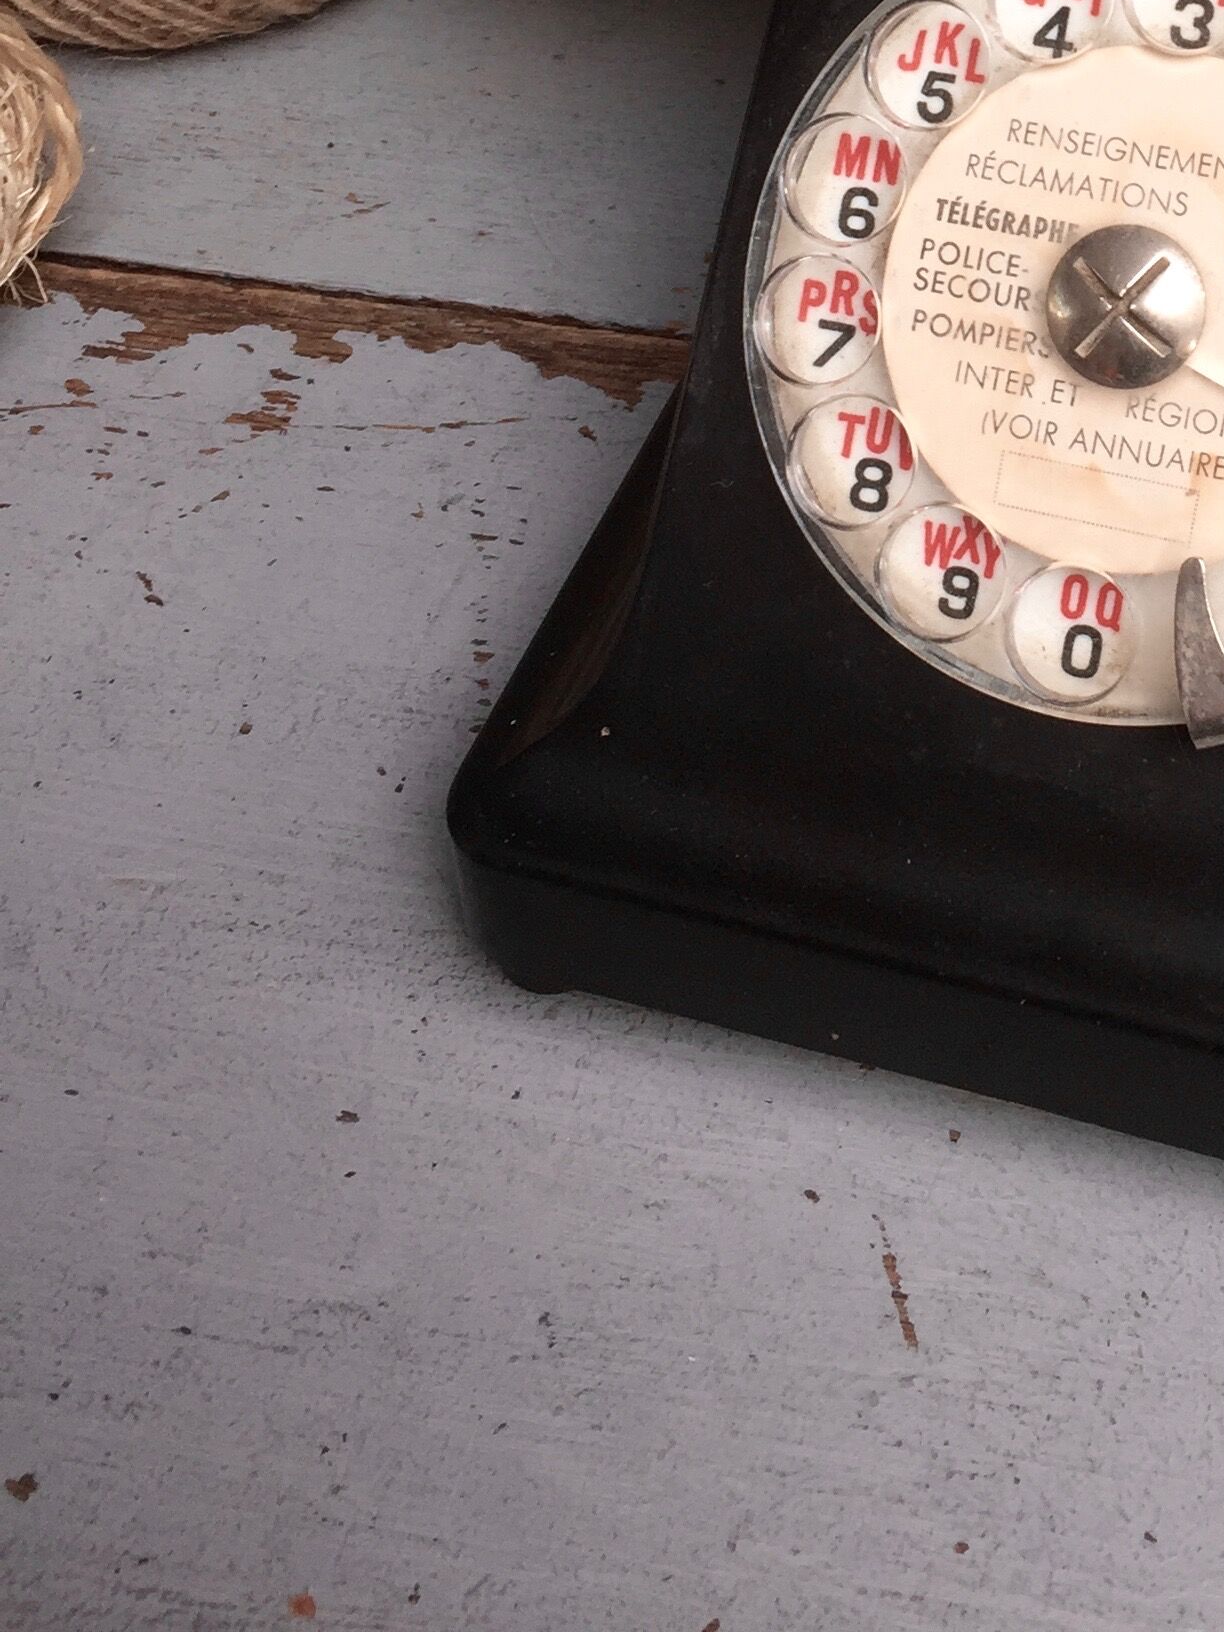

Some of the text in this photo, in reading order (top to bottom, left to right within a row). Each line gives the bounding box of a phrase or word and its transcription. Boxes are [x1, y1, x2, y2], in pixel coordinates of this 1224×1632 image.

[897, 21, 985, 84] JKL
[1033, 6, 1077, 59] 4
[917, 70, 956, 124] 5
[833, 132, 901, 186] MN
[965, 150, 1189, 216] RÉCLAMATIONS
[838, 186, 879, 239] 6
[920, 238, 1029, 277] POLICE-
[797, 270, 878, 336] PRS
[913, 267, 1038, 312] SECOUR
[813, 319, 857, 367] 7
[1051, 379, 1082, 407] ET
[982, 409, 1058, 447] (VOIR
[850, 457, 893, 513] 8
[923, 515, 1001, 580] WXY
[938, 566, 980, 620] 9
